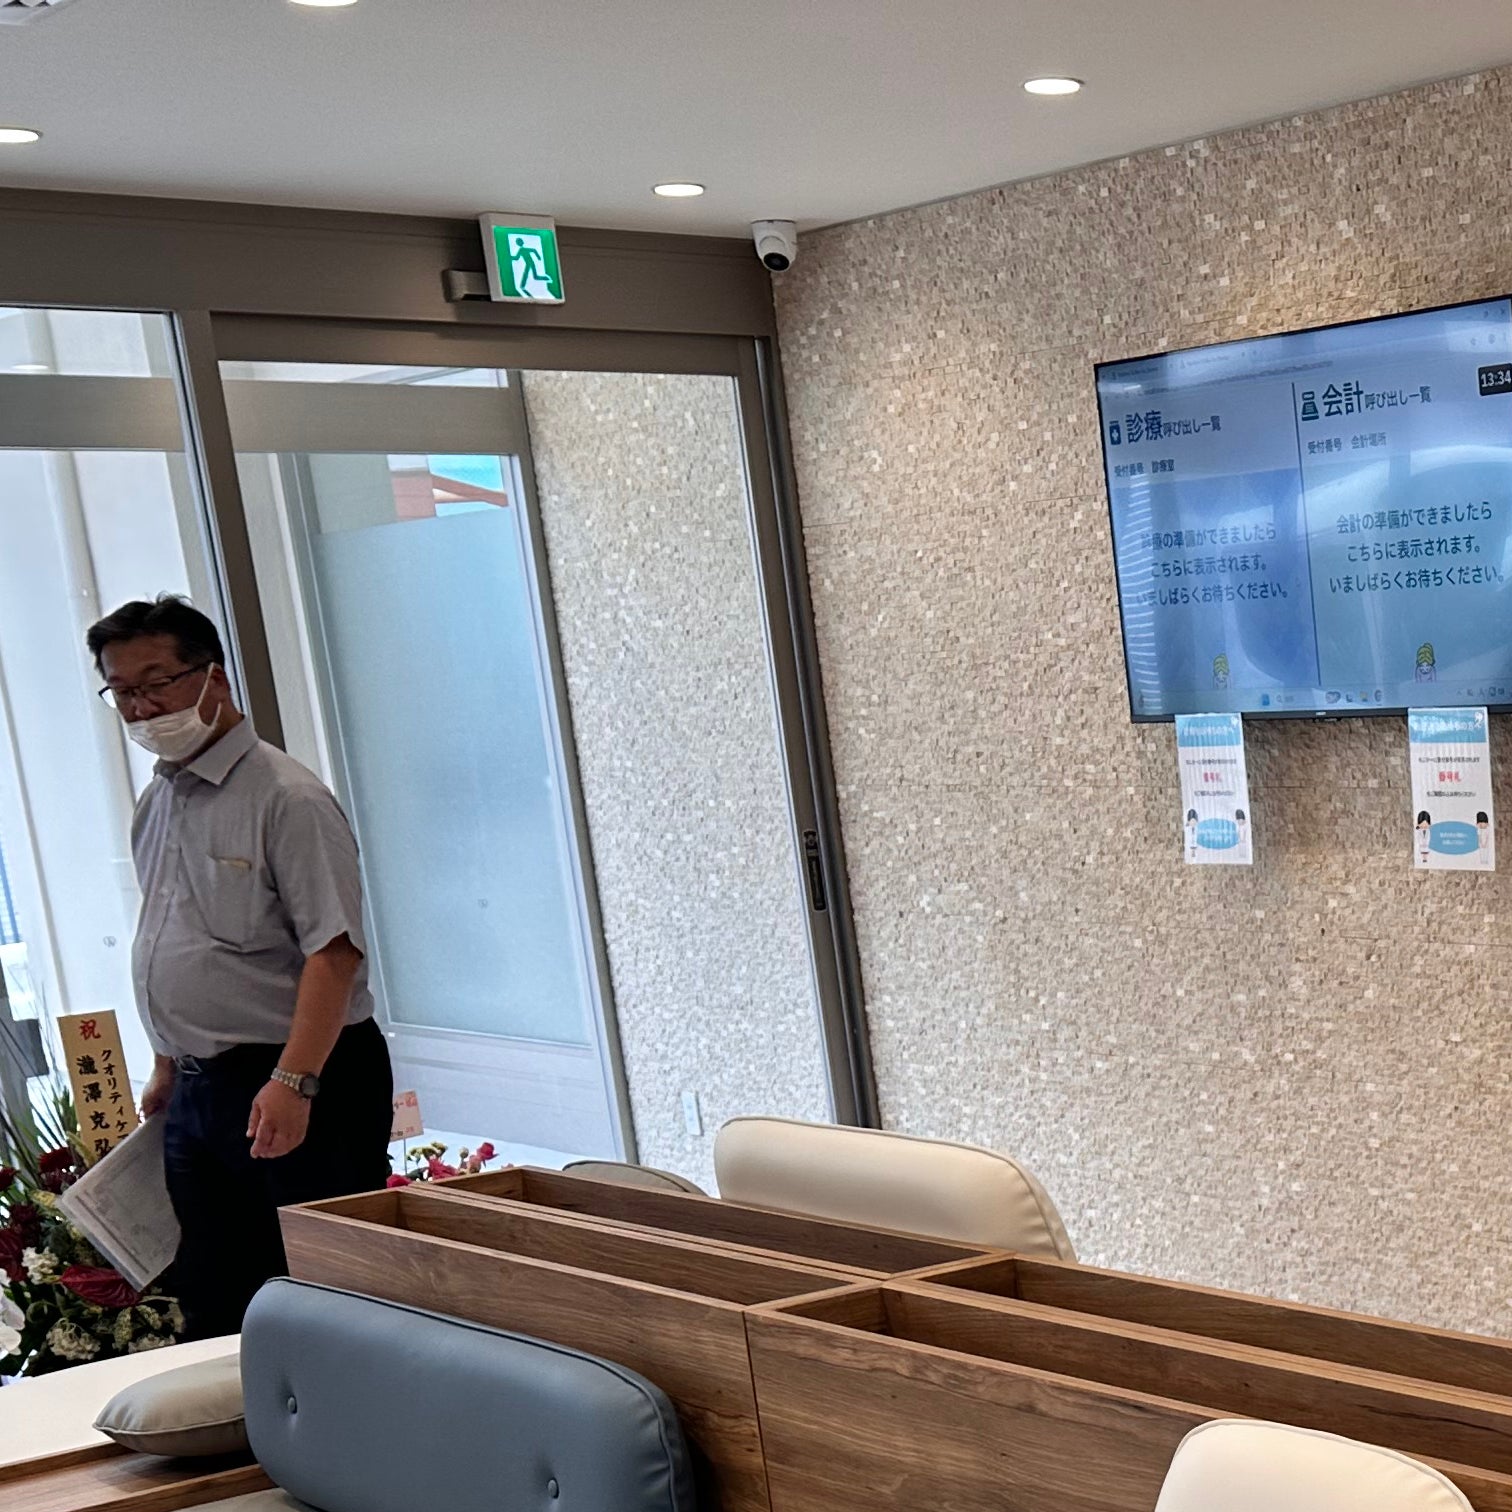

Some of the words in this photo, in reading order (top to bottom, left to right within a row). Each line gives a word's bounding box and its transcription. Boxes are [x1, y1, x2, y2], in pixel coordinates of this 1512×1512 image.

[1480, 369, 1512, 388] 13:34
[1322, 380, 1432, 417] 会計呼び出し一覧
[1125, 410, 1221, 444] 診療呼び出し一覧
[1307, 437, 1342, 455] 受付番号
[1336, 501, 1492, 534] 会計の準備ができましたら
[1347, 534, 1481, 562] こちらに表示されます。
[1151, 553, 1267, 578] こちらに表示されます。
[1329, 566, 1505, 594] いましばらくお待ちください。
[79, 1019, 102, 1040] 祝
